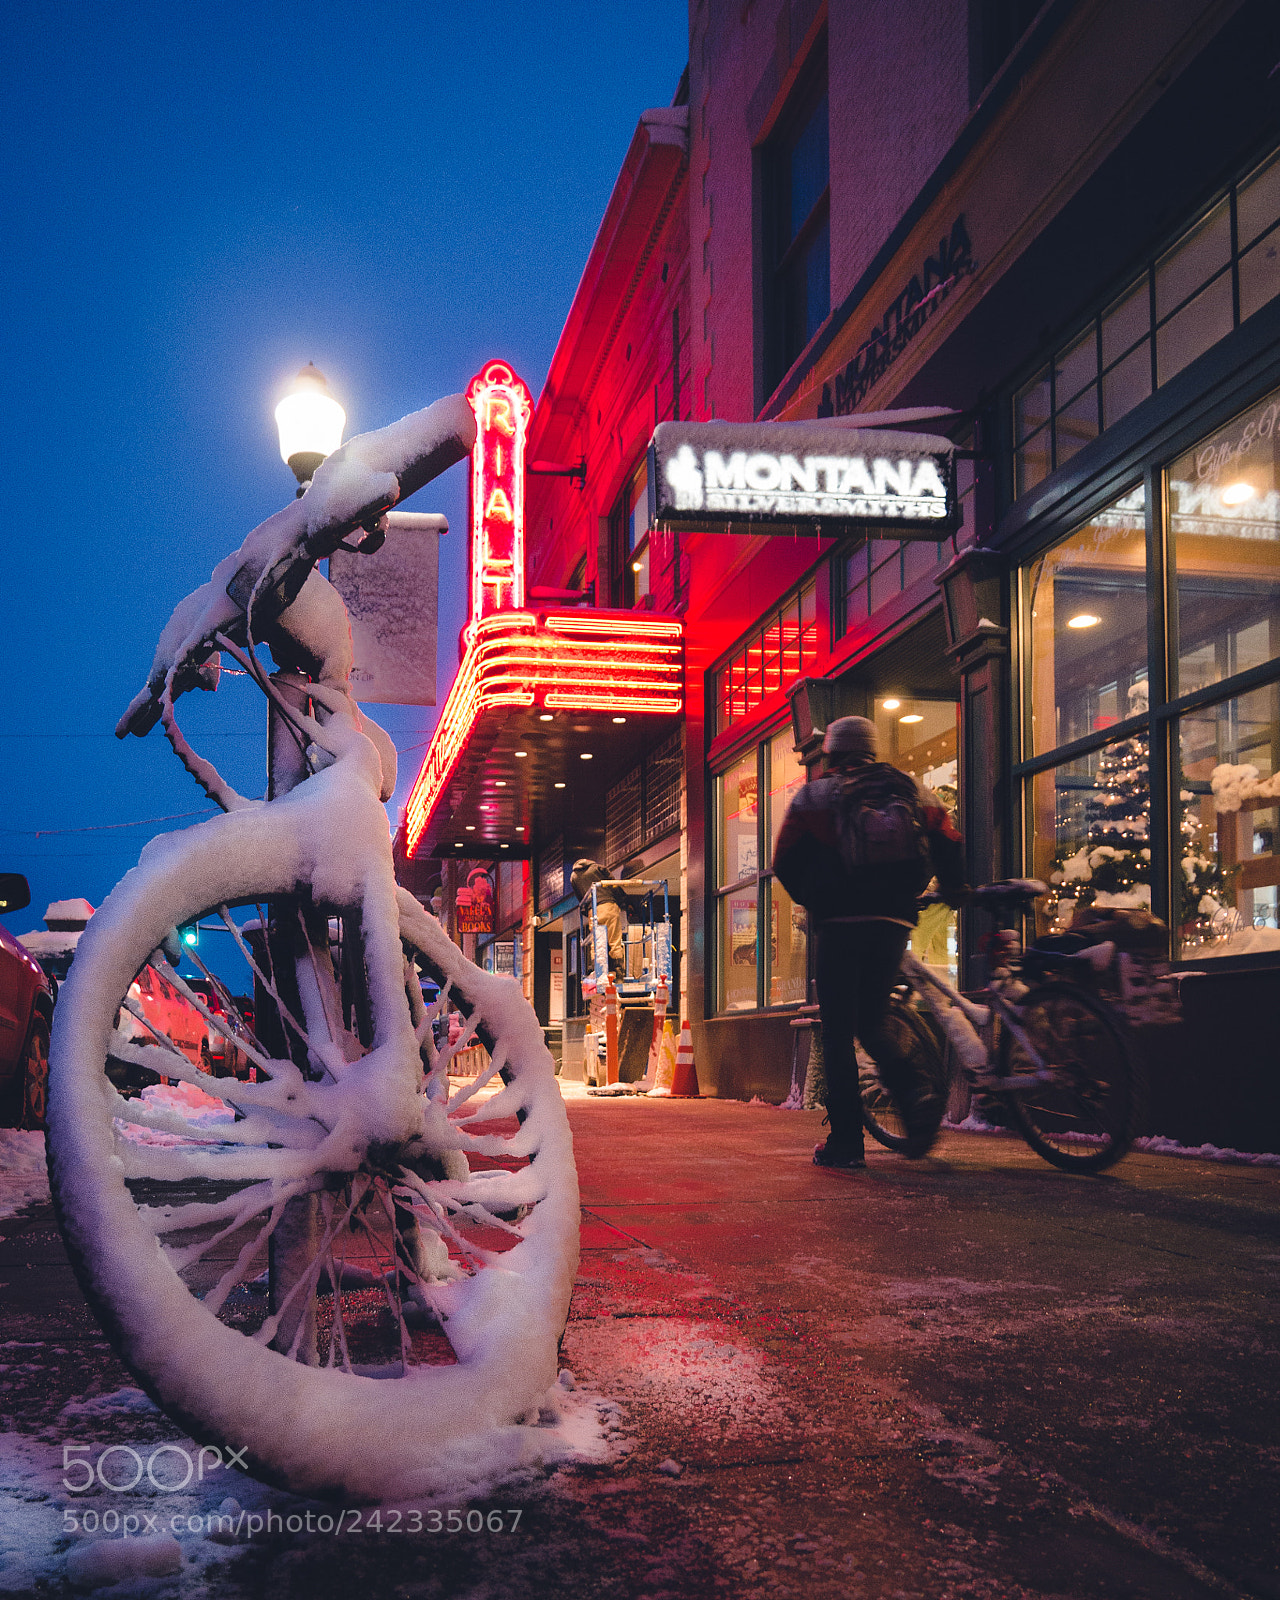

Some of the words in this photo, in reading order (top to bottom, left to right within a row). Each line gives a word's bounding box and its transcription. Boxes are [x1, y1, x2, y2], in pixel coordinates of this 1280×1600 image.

[834, 213, 972, 403] MONTANA
[704, 452, 947, 497] MONTANA
[462, 921, 491, 932] BOOKS
